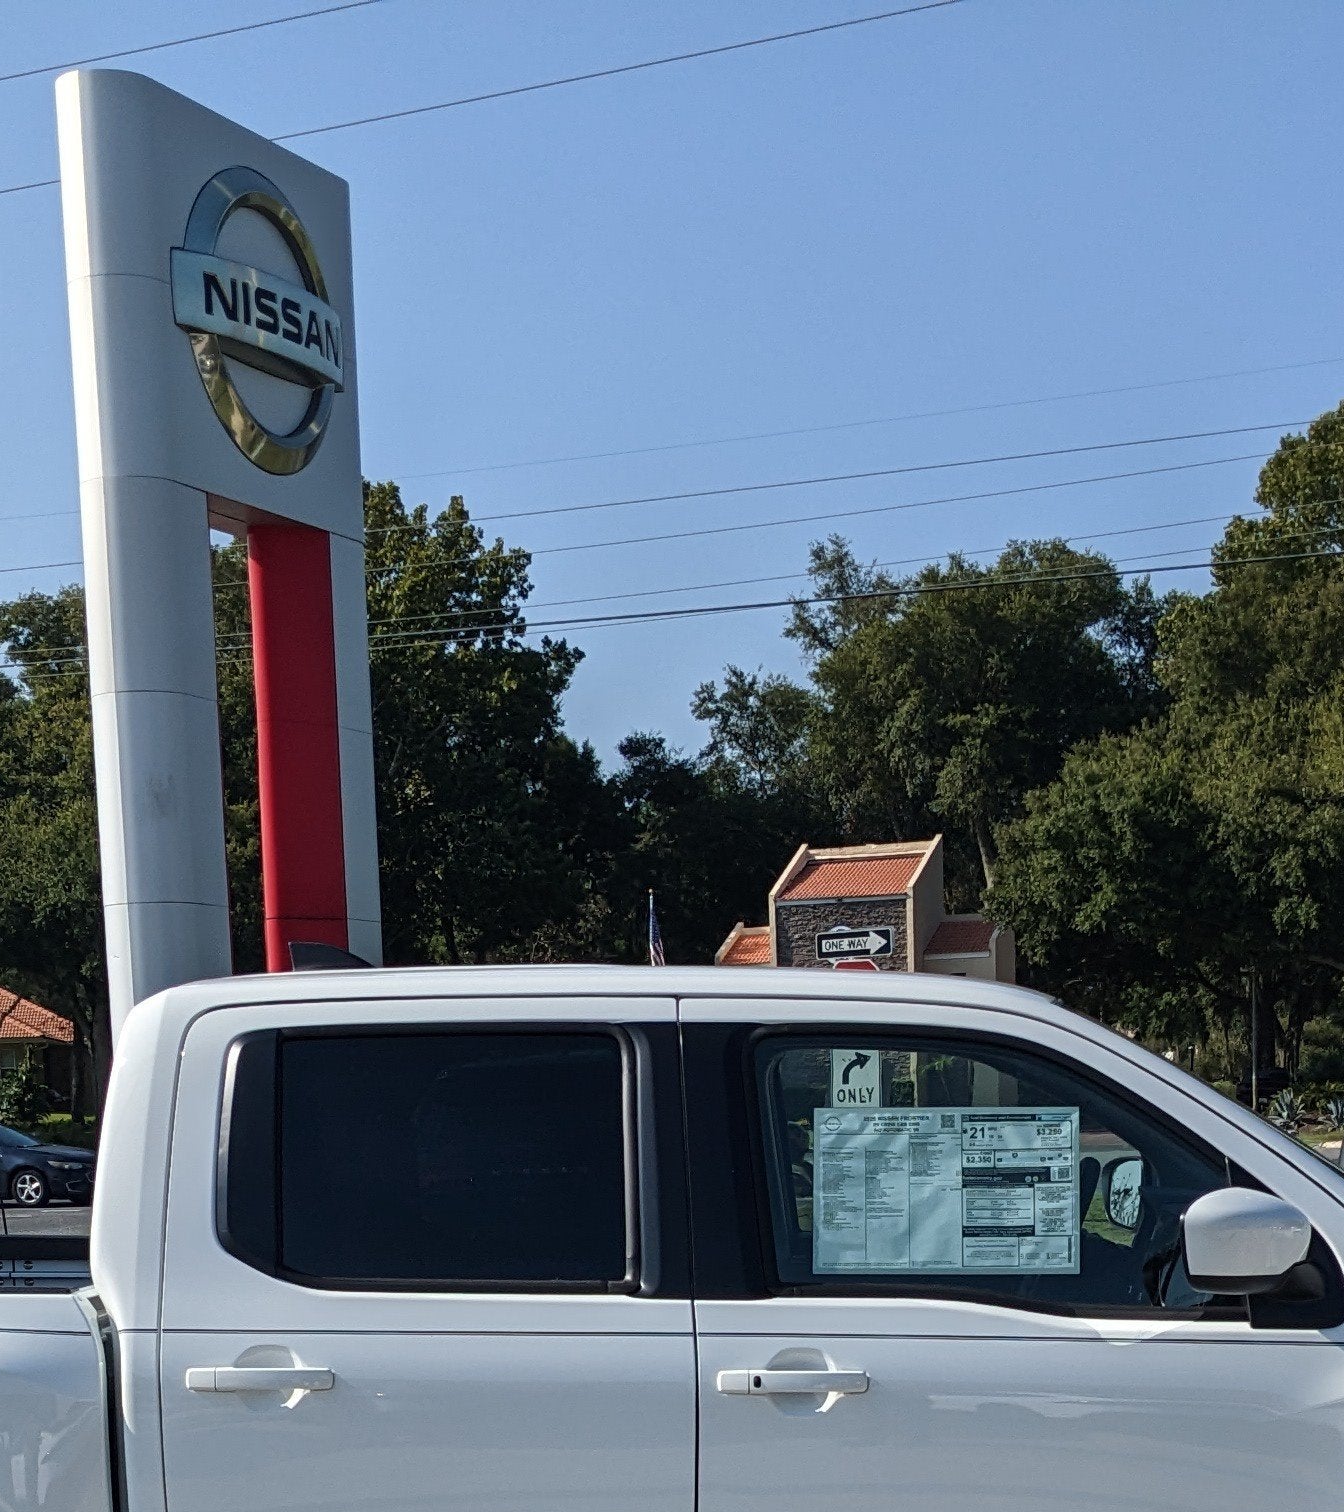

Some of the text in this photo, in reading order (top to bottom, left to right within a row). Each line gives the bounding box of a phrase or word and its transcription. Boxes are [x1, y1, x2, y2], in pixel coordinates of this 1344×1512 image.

[202, 270, 342, 370] NISSAN
[824, 938, 869, 951] ONE WAY
[836, 1087, 874, 1103] ONLY
[969, 1126, 985, 1139] 21
[965, 1155, 992, 1164] $2,350
